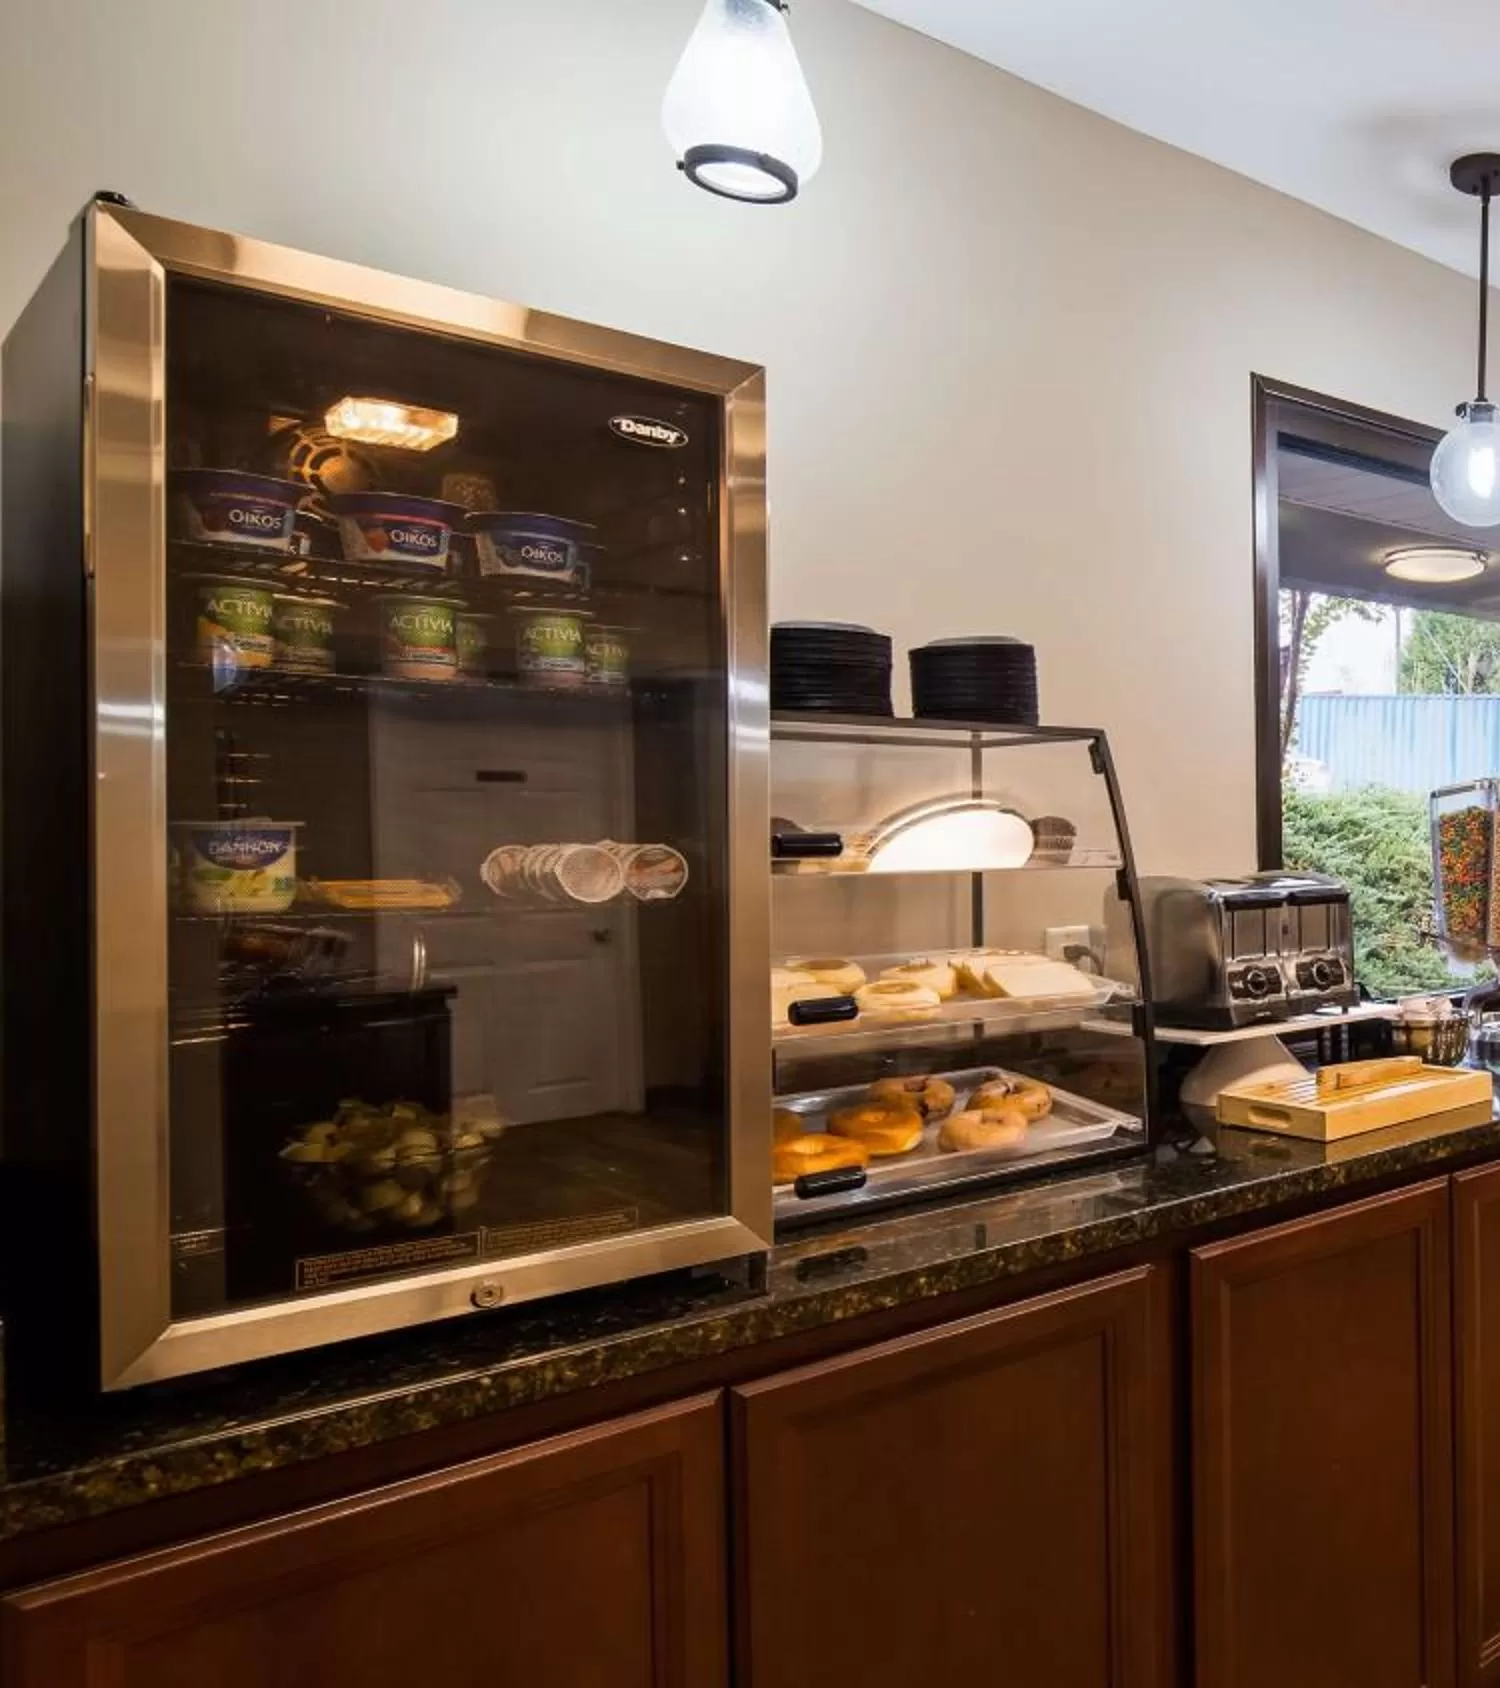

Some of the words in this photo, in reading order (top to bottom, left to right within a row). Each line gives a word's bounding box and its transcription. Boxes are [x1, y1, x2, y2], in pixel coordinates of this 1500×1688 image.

[613, 419, 681, 444] Danby
[228, 509, 282, 529] OIKOS
[390, 529, 437, 548] OIKOS
[521, 545, 564, 563] OIKOS
[523, 627, 582, 642] ACTIVIA
